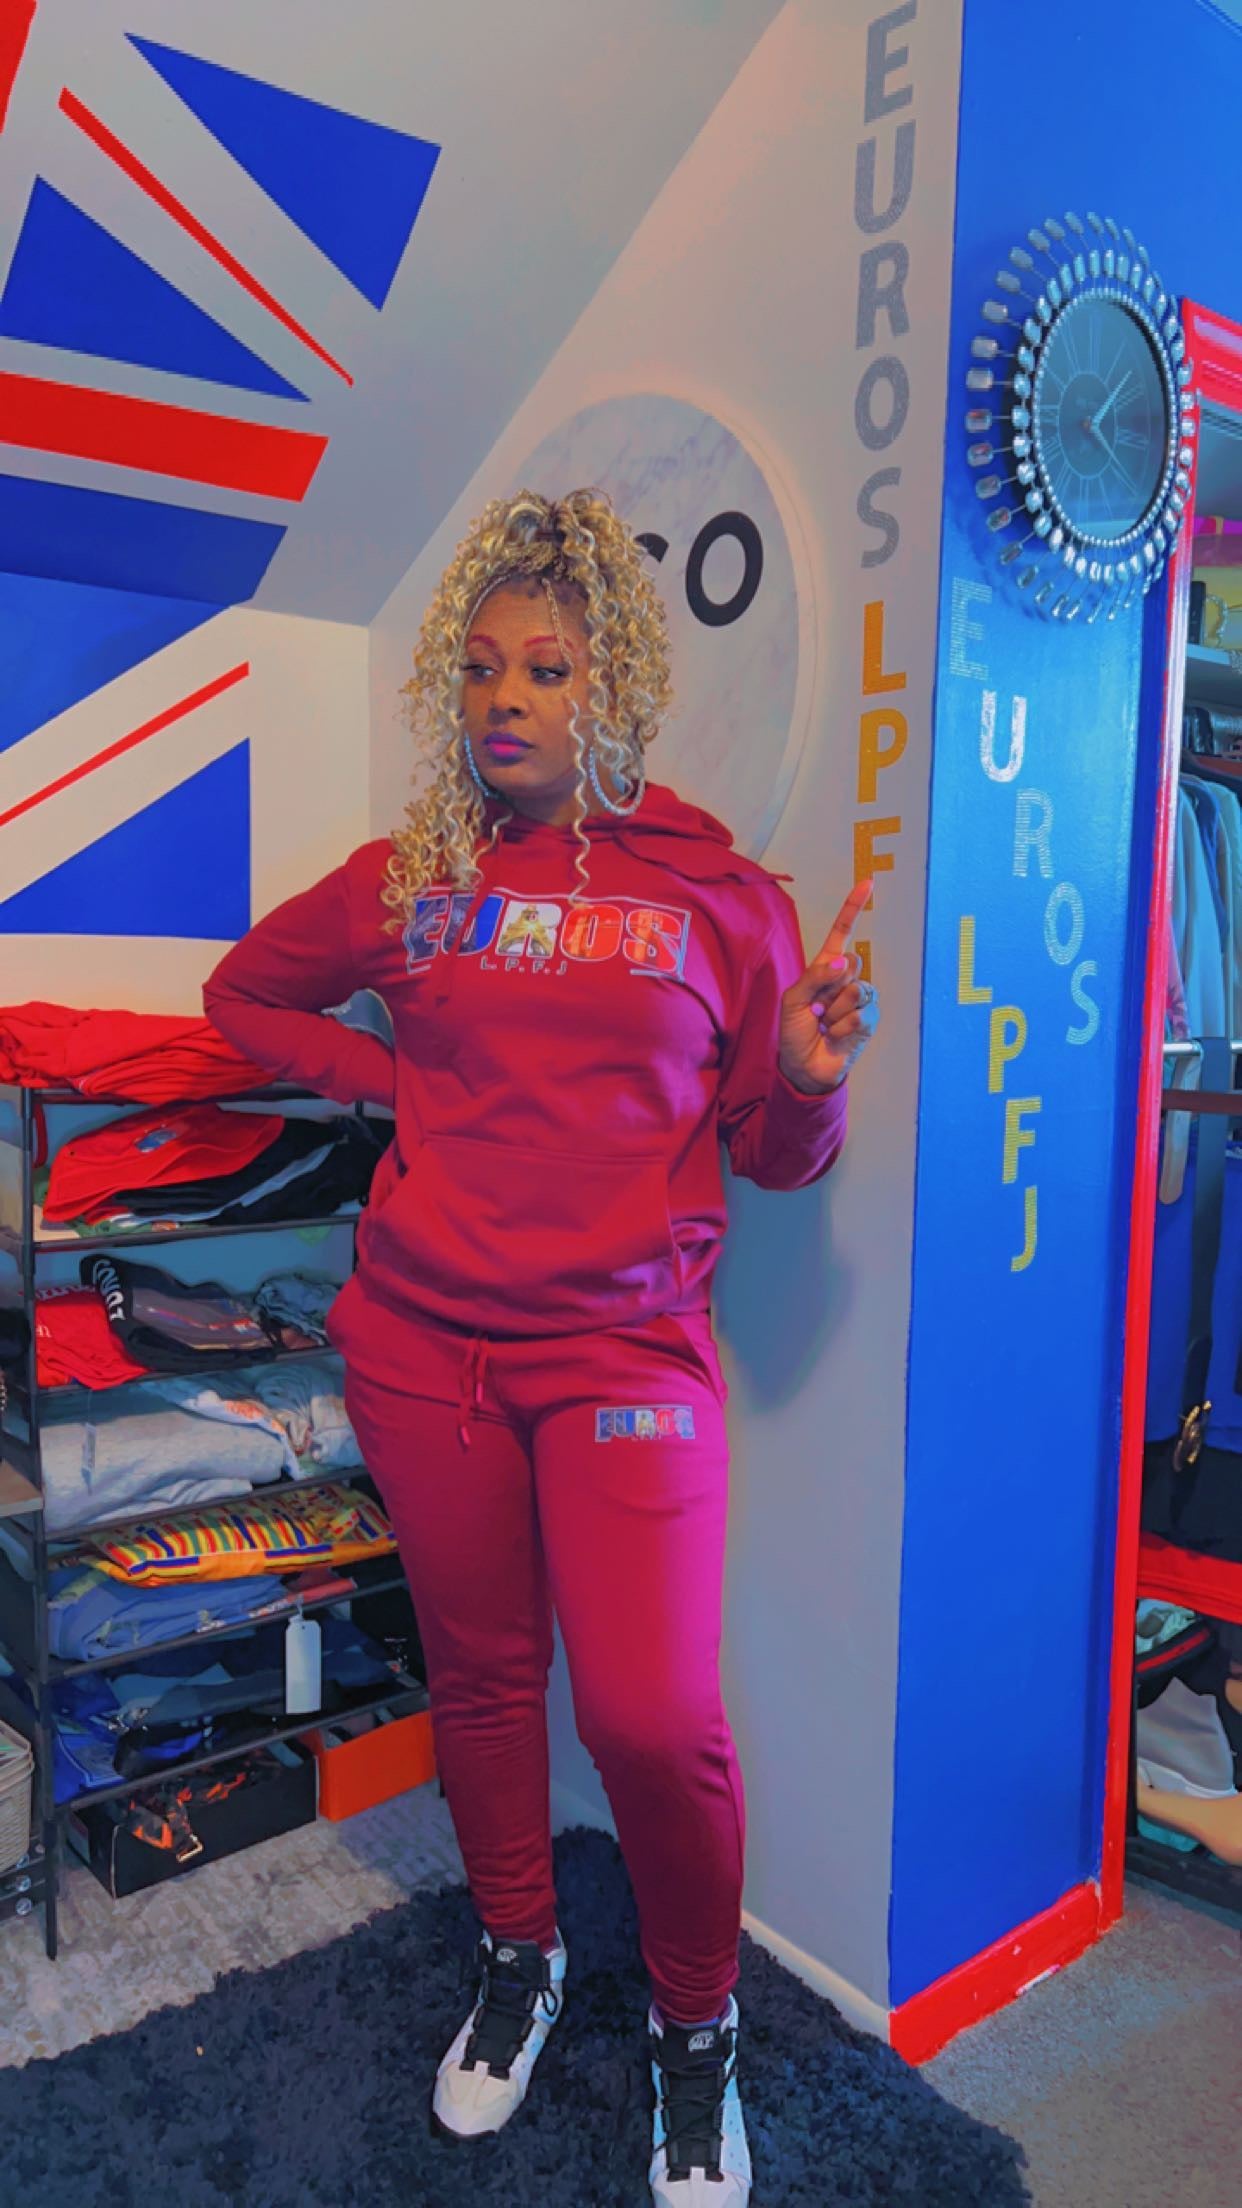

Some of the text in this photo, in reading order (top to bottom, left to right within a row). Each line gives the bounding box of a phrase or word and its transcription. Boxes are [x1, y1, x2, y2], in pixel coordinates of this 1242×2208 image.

[854, 0, 918, 568] EUROS
[404, 893, 688, 974] EUROS
[948, 577, 1099, 1046] EUROS
[957, 916, 1042, 1273] LPFJ
